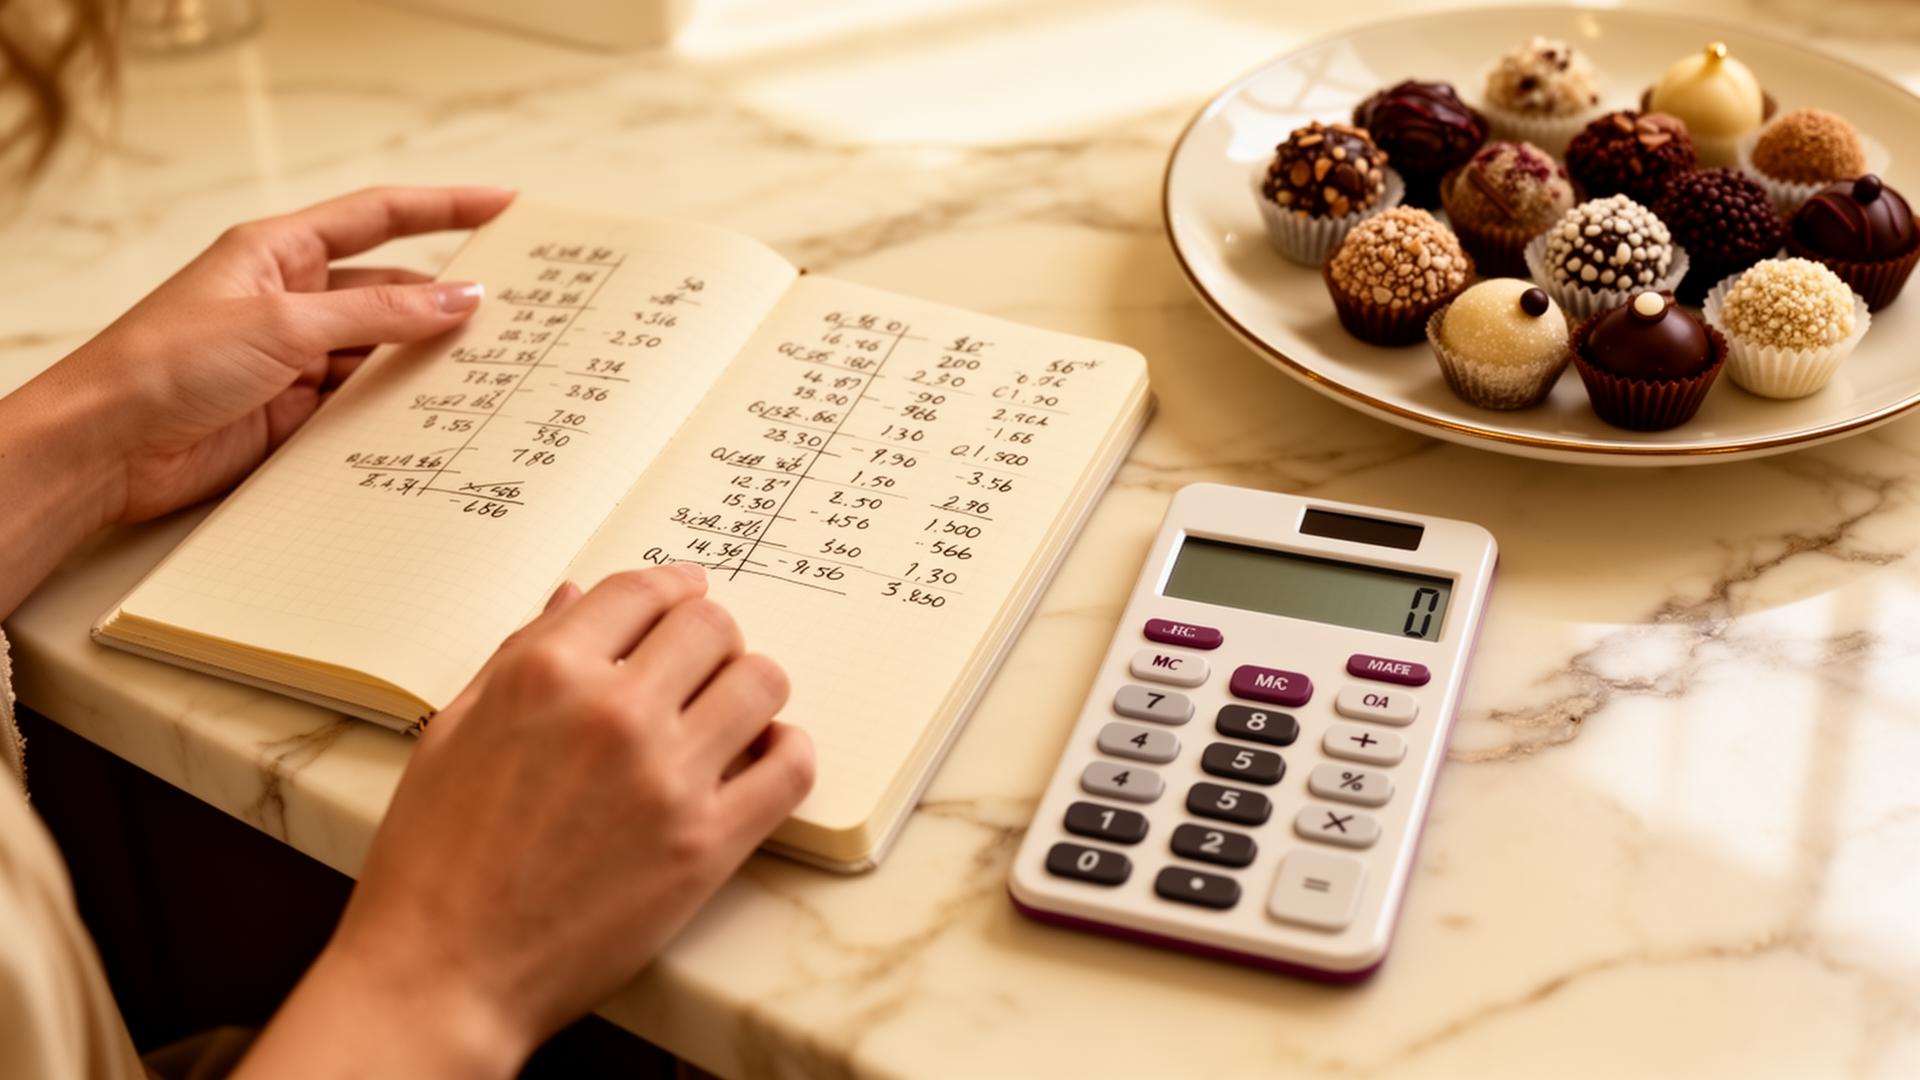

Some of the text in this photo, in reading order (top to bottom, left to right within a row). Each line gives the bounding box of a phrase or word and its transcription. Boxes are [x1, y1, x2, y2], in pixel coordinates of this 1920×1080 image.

[1403, 587, 1440, 638] 0
[1152, 655, 1183, 670] MC
[1147, 692, 1165, 709] 7
[1246, 712, 1267, 731] 8
[1130, 732, 1149, 750] 4
[1231, 751, 1254, 770] 5
[1112, 771, 1131, 788] 4
[1338, 771, 1365, 792] %
[1216, 791, 1240, 810] 5
[1101, 811, 1116, 830] 1
[1200, 833, 1225, 854] 2
[1076, 850, 1100, 872] 0
